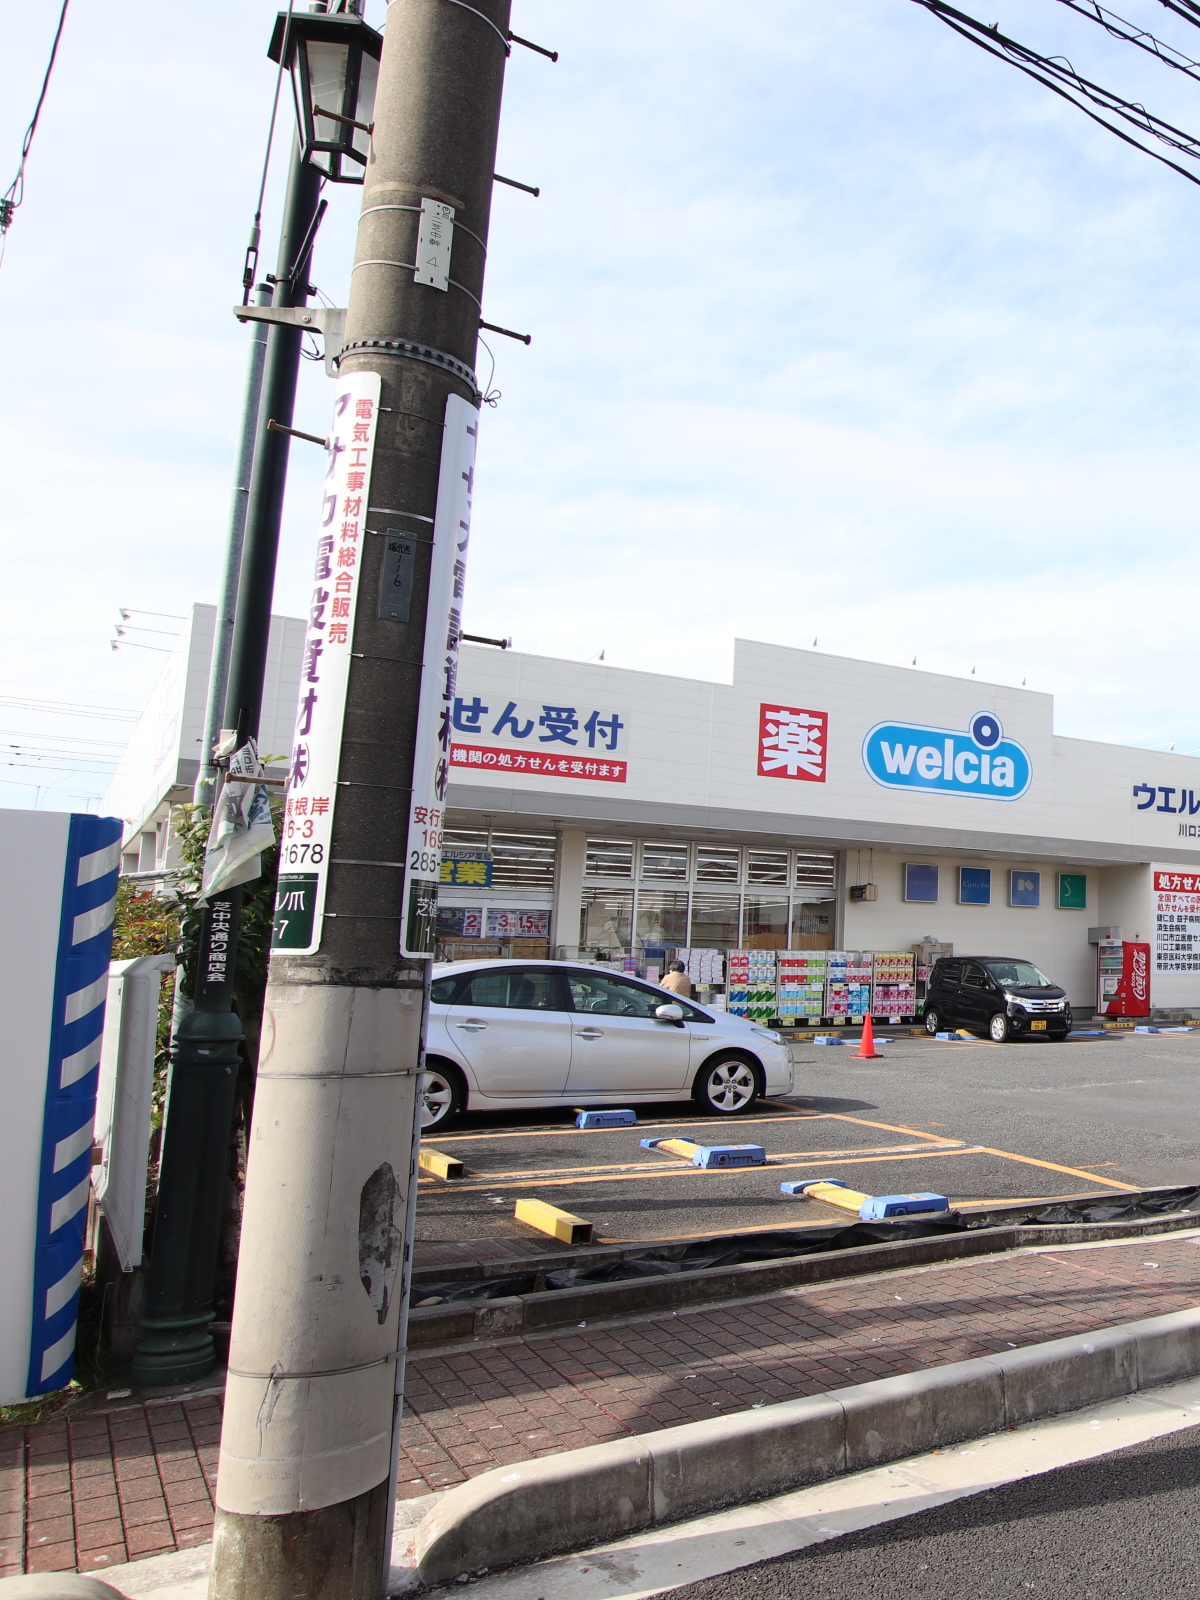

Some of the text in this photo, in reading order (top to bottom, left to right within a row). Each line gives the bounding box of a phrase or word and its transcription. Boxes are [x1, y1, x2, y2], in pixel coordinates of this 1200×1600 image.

[328, 399, 374, 645] 電気工事材料総合販売
[451, 697, 624, 750] せん受付
[761, 710, 823, 777] 薬
[452, 748, 624, 778] 機関の処方せんを受付ます
[880, 738, 1015, 788] welcia
[207, 902, 232, 982] 芝中央通り商店会
[1132, 948, 1147, 1000] Coca-Cola
